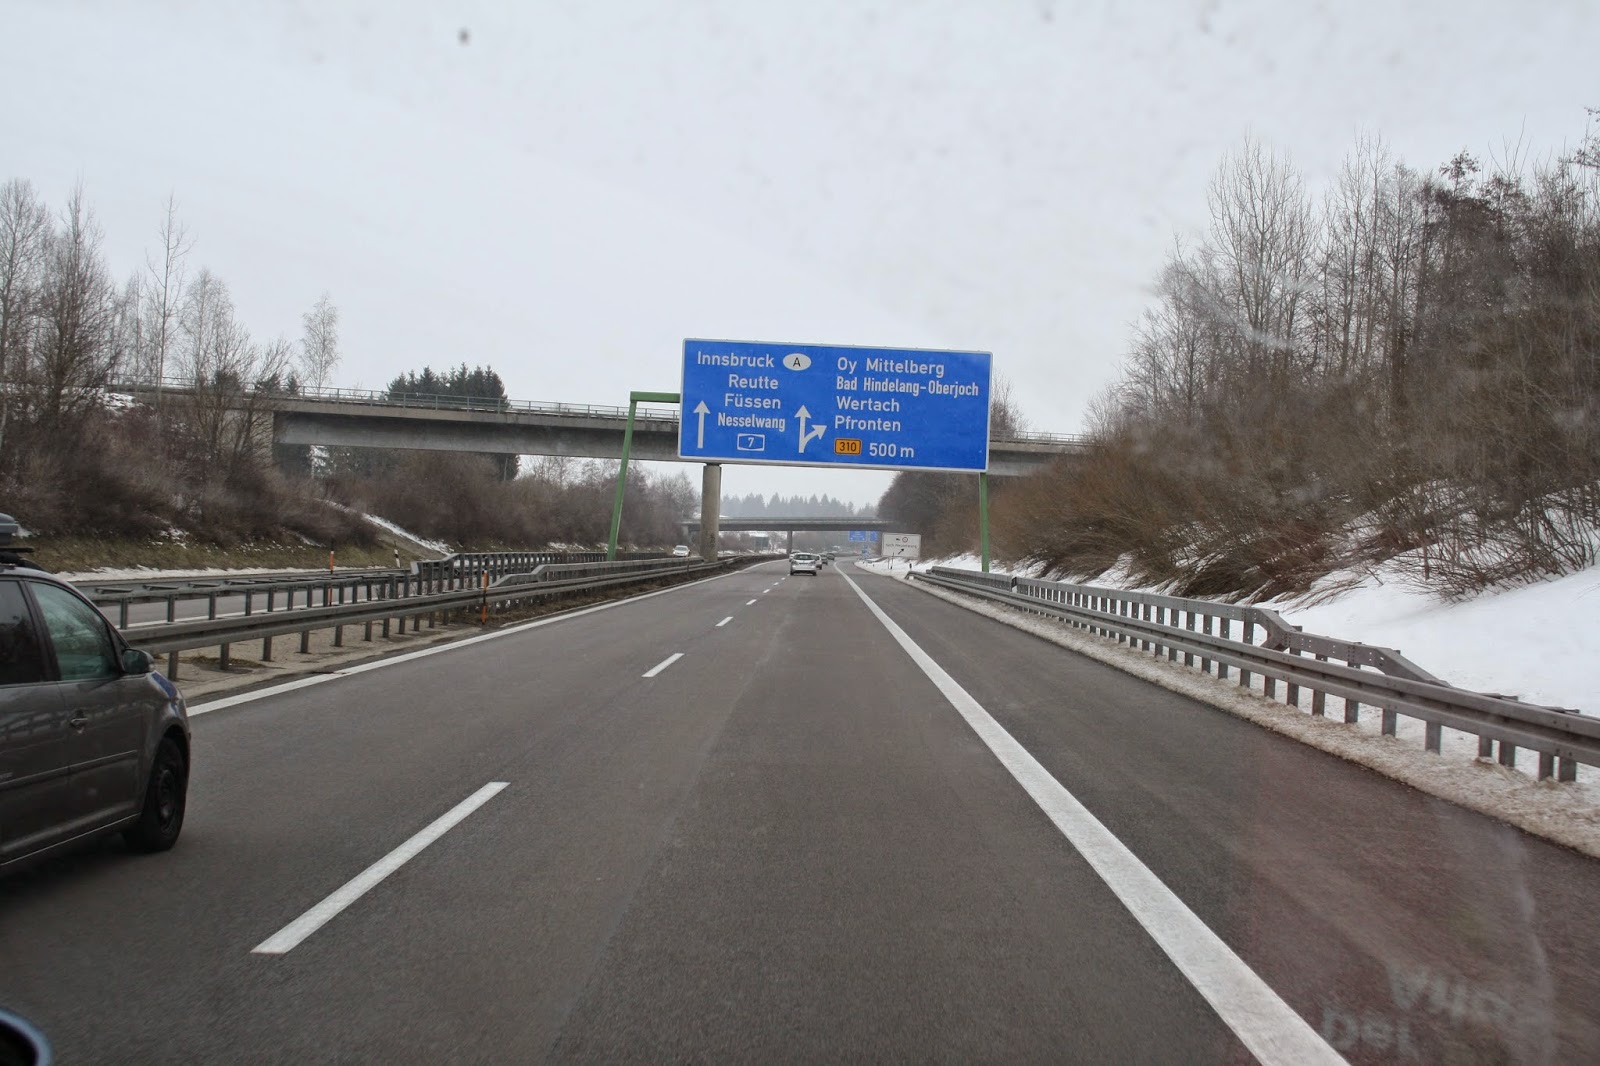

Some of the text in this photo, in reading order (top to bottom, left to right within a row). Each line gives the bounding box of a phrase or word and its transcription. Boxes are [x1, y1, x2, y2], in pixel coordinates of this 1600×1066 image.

[697, 351, 774, 368] Innsbruck
[792, 357, 801, 367] A
[837, 357, 945, 378] Oy Mittelberg
[728, 373, 778, 389] Reutte
[836, 376, 979, 398] Bad Hindelang-Oberjoch
[724, 393, 781, 409] Füssen
[836, 395, 900, 412] Wertach
[717, 412, 786, 432] Nesselwang
[834, 415, 901, 432] Pfronten
[747, 437, 755, 448] 7
[839, 441, 857, 452] 310
[869, 442, 915, 458] 500 m
